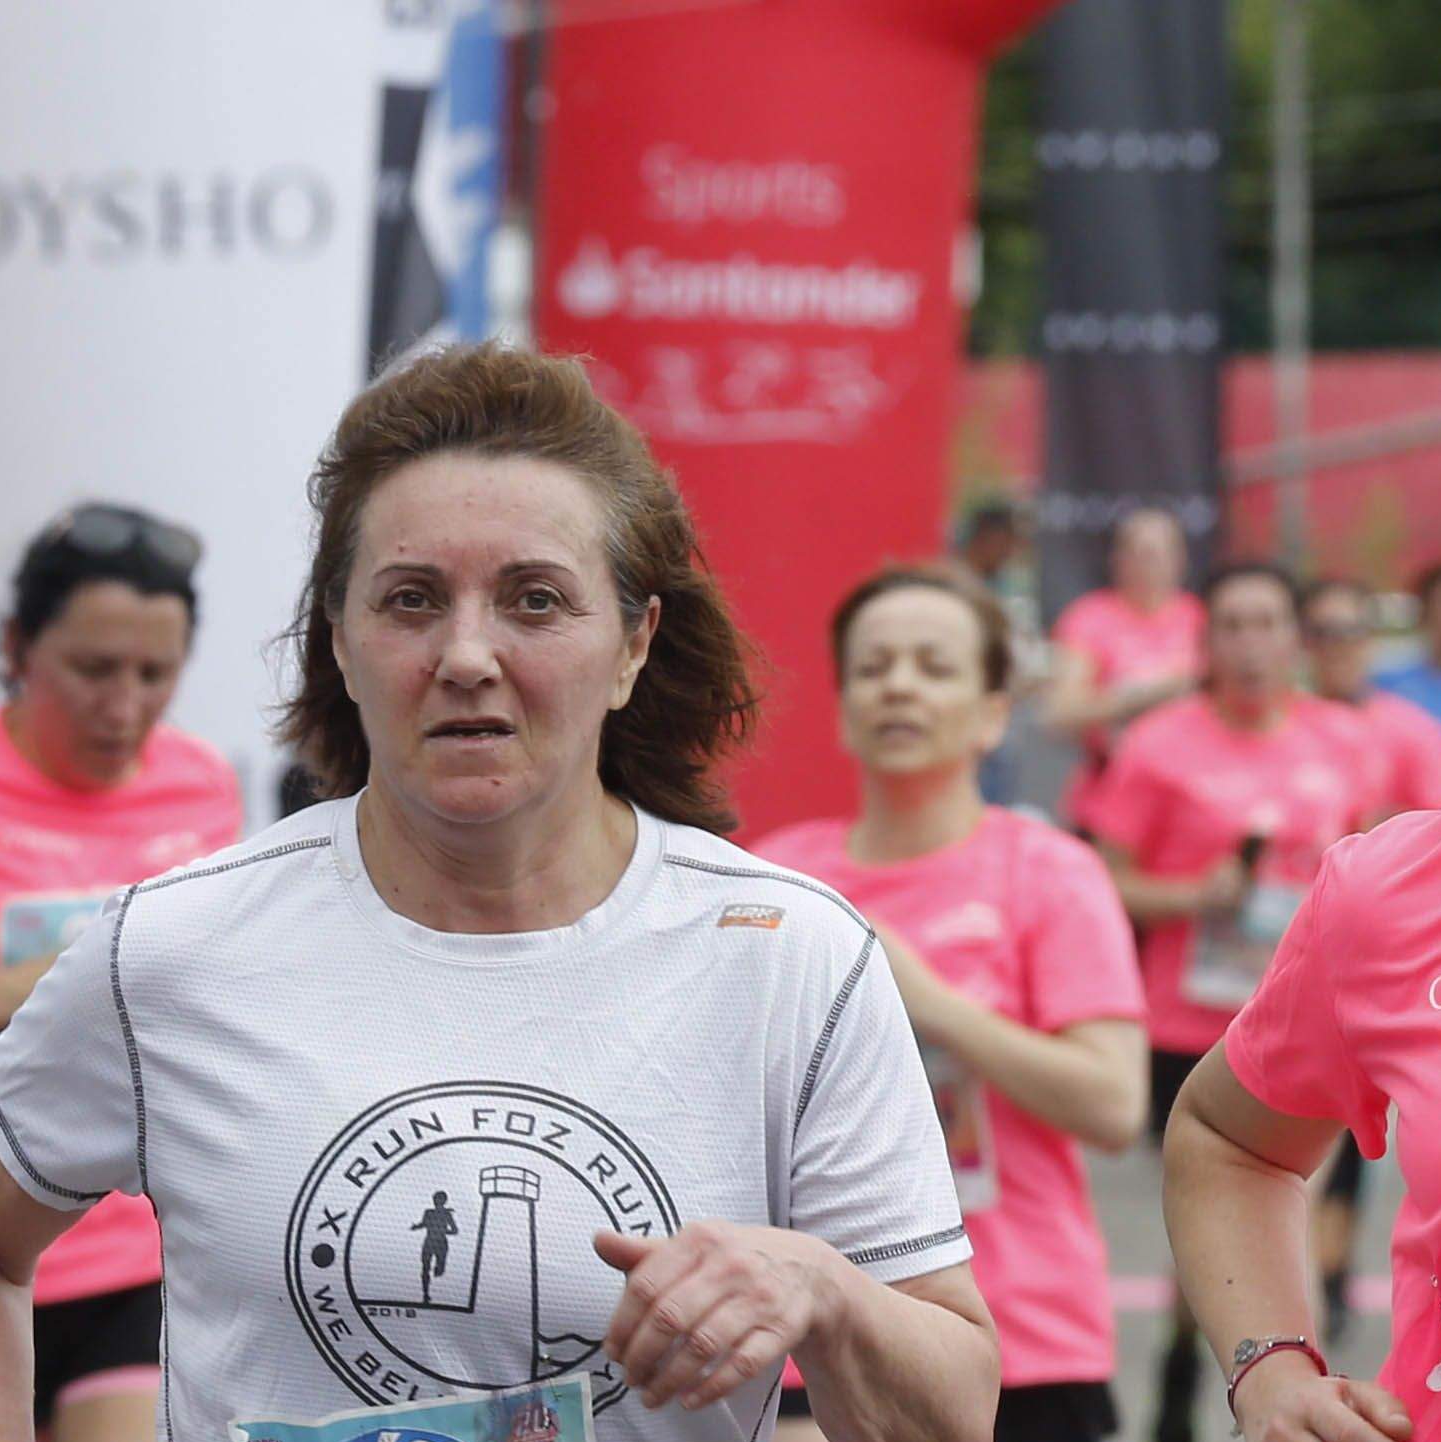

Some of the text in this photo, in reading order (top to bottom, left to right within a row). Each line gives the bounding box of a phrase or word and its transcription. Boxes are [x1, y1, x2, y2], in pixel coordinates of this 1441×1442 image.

[622, 247, 920, 328] Santander
[317, 1207, 348, 1237] X
[344, 1111, 445, 1188] RUN
[472, 1108, 572, 1150] FOZ
[312, 1284, 353, 1342] WE
